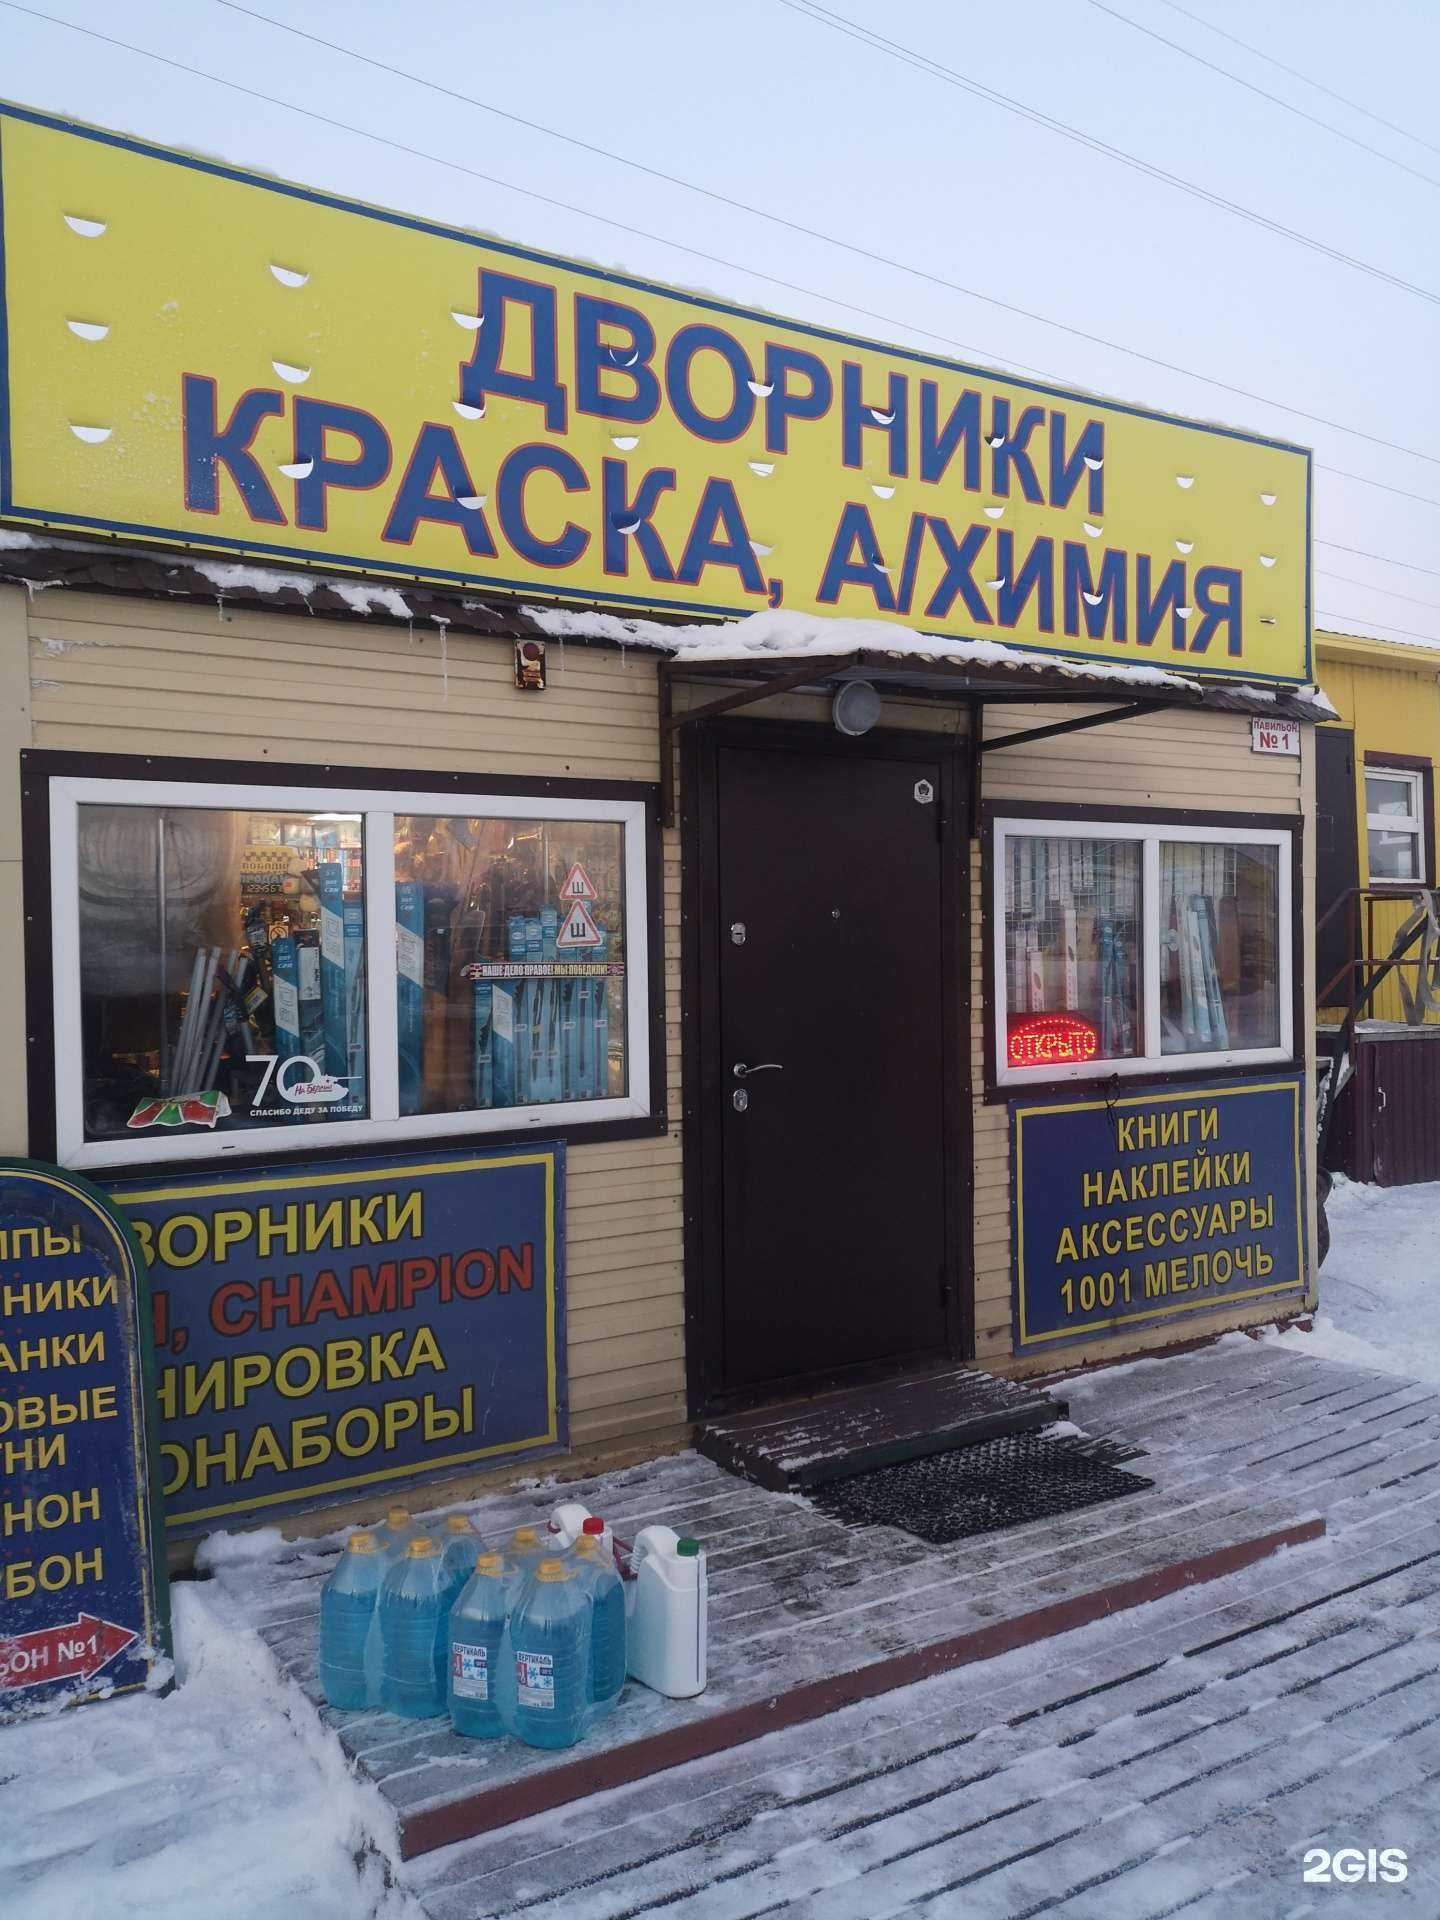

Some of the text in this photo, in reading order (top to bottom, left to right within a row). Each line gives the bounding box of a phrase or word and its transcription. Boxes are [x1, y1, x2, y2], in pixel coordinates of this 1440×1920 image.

[459, 267, 1105, 516] ДВОРНИКИ
[181, 372, 1244, 658] КРАСКА, А/ХИМИЯ
[1253, 720, 1298, 732] ПАВИЛЬОН
[572, 881, 584, 894] Ш
[570, 922, 586, 937] Ш
[504, 964, 524, 978] ДЕЛО
[1010, 1030, 1096, 1059] ОТКРЫТО
[245, 1055, 322, 1107] 70
[250, 1105, 364, 1117] СПАСИБО ДЕДУ ЗА ПОБЕДУ
[1117, 1106, 1219, 1153] КНИГИ
[1082, 1148, 1252, 1208] НАКЛЕЙКИ
[1055, 1194, 1274, 1264] АКСЕССУАРЫ
[210, 1243, 534, 1337] CHAMPION
[1061, 1243, 1274, 1315] 1001 МЕЛОЧЬ
[0, 1433, 66, 1475] НИ
[160, 1387, 473, 1497] ОНАБОРЫ
